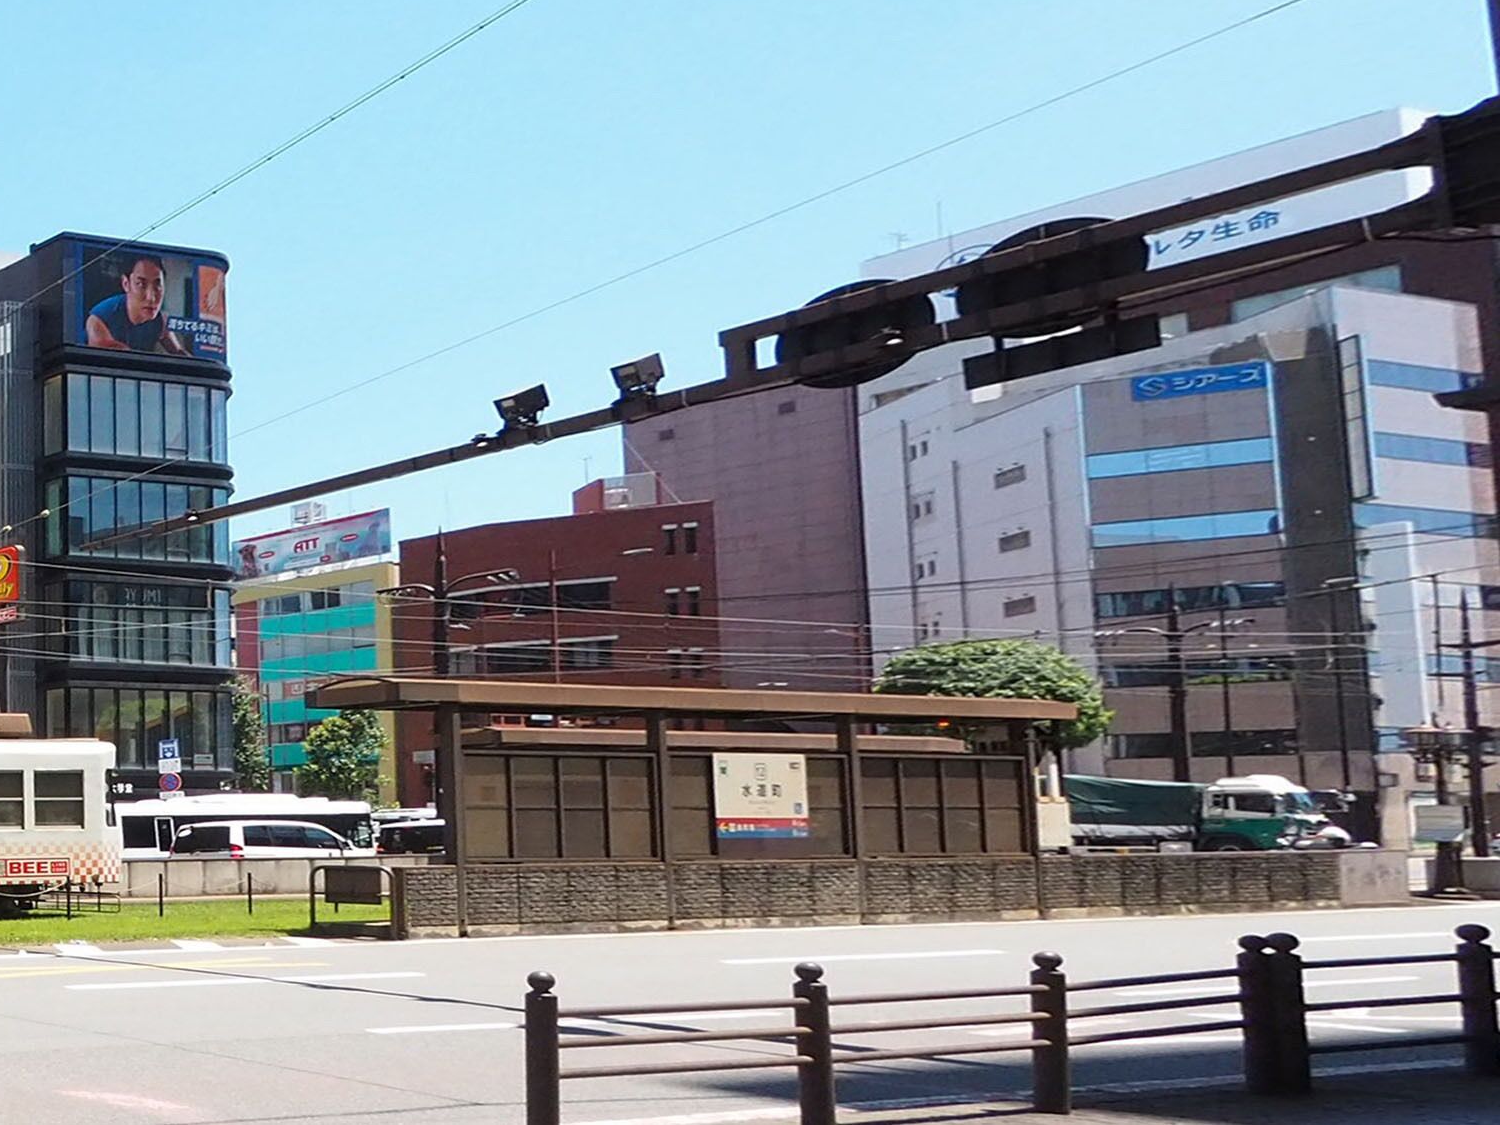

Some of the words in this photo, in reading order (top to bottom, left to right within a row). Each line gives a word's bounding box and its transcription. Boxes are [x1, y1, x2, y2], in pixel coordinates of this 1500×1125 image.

[1172, 366, 1262, 390] シアーズ
[293, 537, 320, 554] ATT
[741, 783, 782, 797] 水道町
[9, 862, 49, 874] BEE
